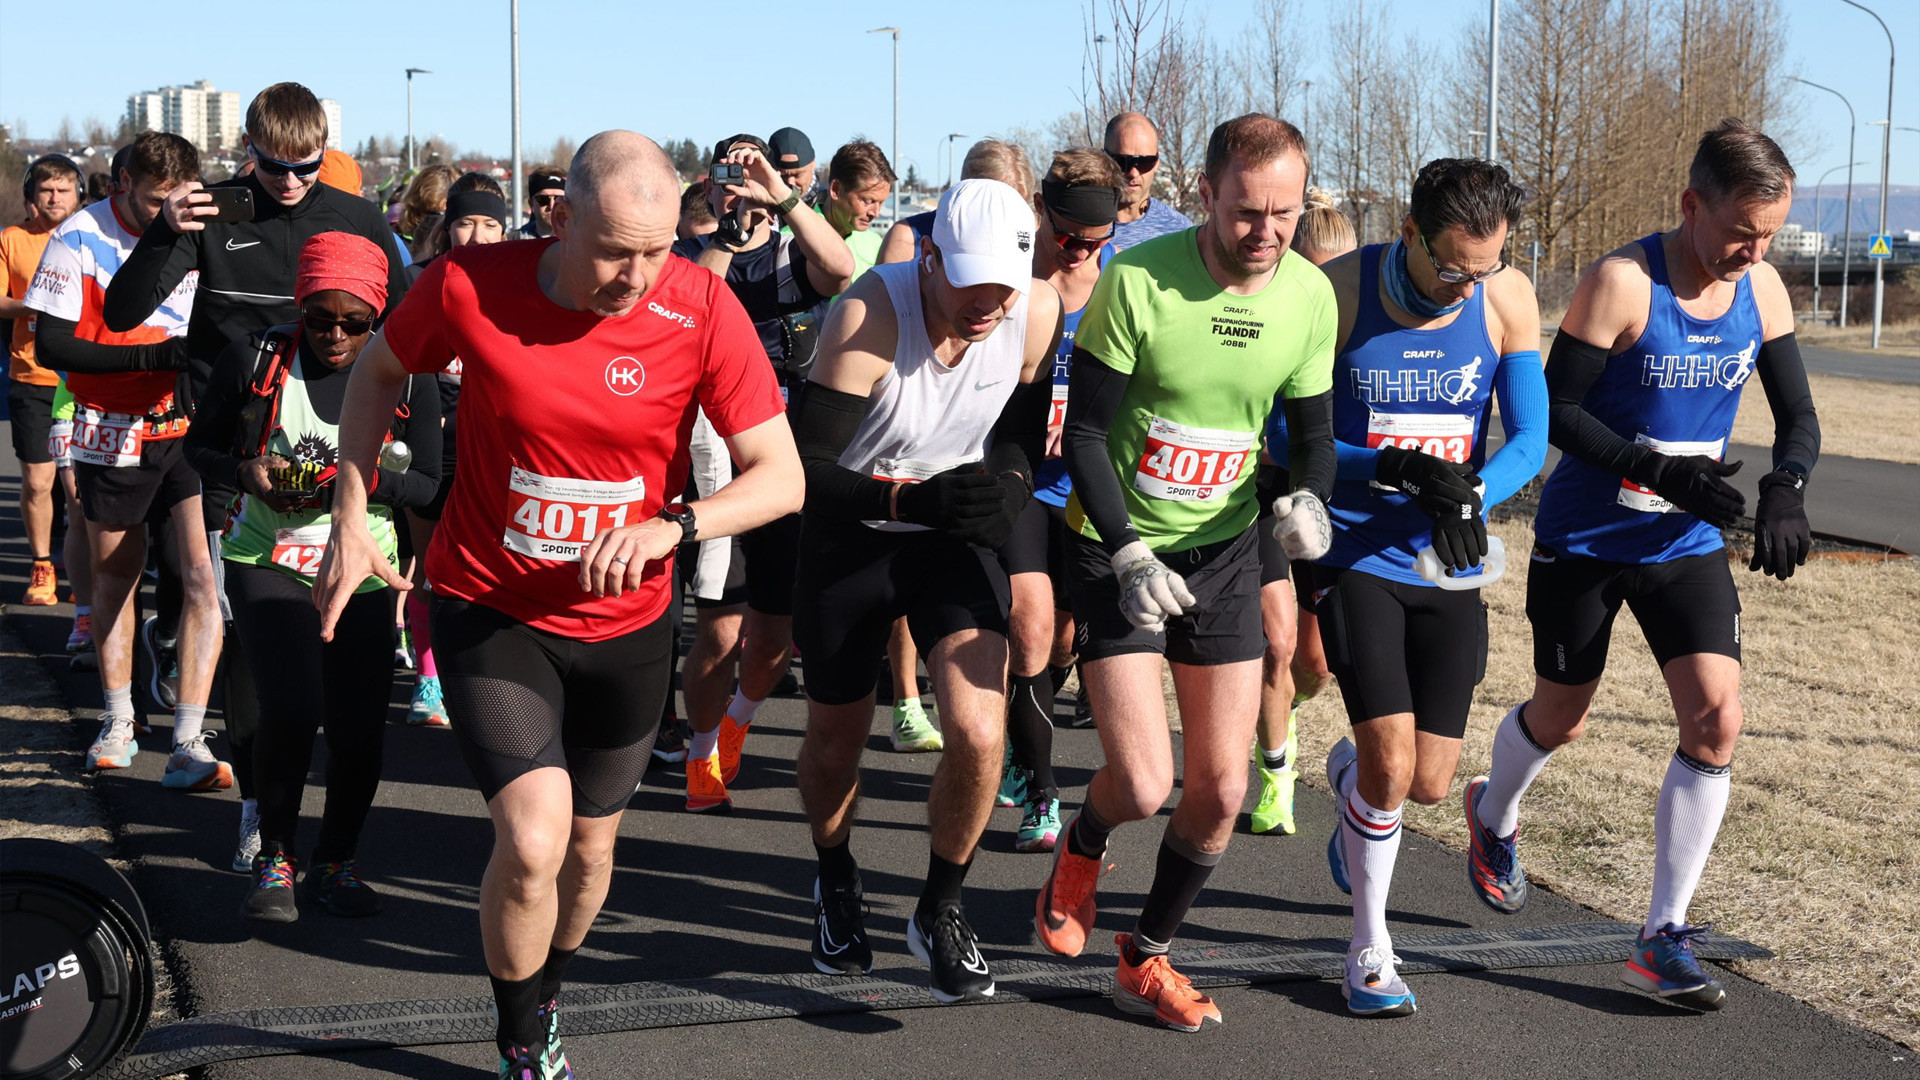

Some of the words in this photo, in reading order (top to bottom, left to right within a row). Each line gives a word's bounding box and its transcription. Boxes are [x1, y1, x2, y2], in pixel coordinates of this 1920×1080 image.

[647, 301, 687, 323] CRAFT
[1223, 306, 1249, 315] CRAFT
[1210, 316, 1264, 328] HLAUPAHÓPURINN
[1212, 324, 1260, 339] FLANDRI
[1220, 339, 1247, 349] JOBBI
[1687, 334, 1715, 344] CRAFT
[1403, 350, 1436, 359] CRAFT
[611, 366, 640, 386] HK
[73, 421, 136, 455] 4036
[1146, 444, 1245, 484] 4018
[1166, 486, 1197, 496] SPORT
[513, 498, 629, 541] 4011
[541, 544, 579, 556] SPORT
[1556, 643, 1566, 672] FUSION
